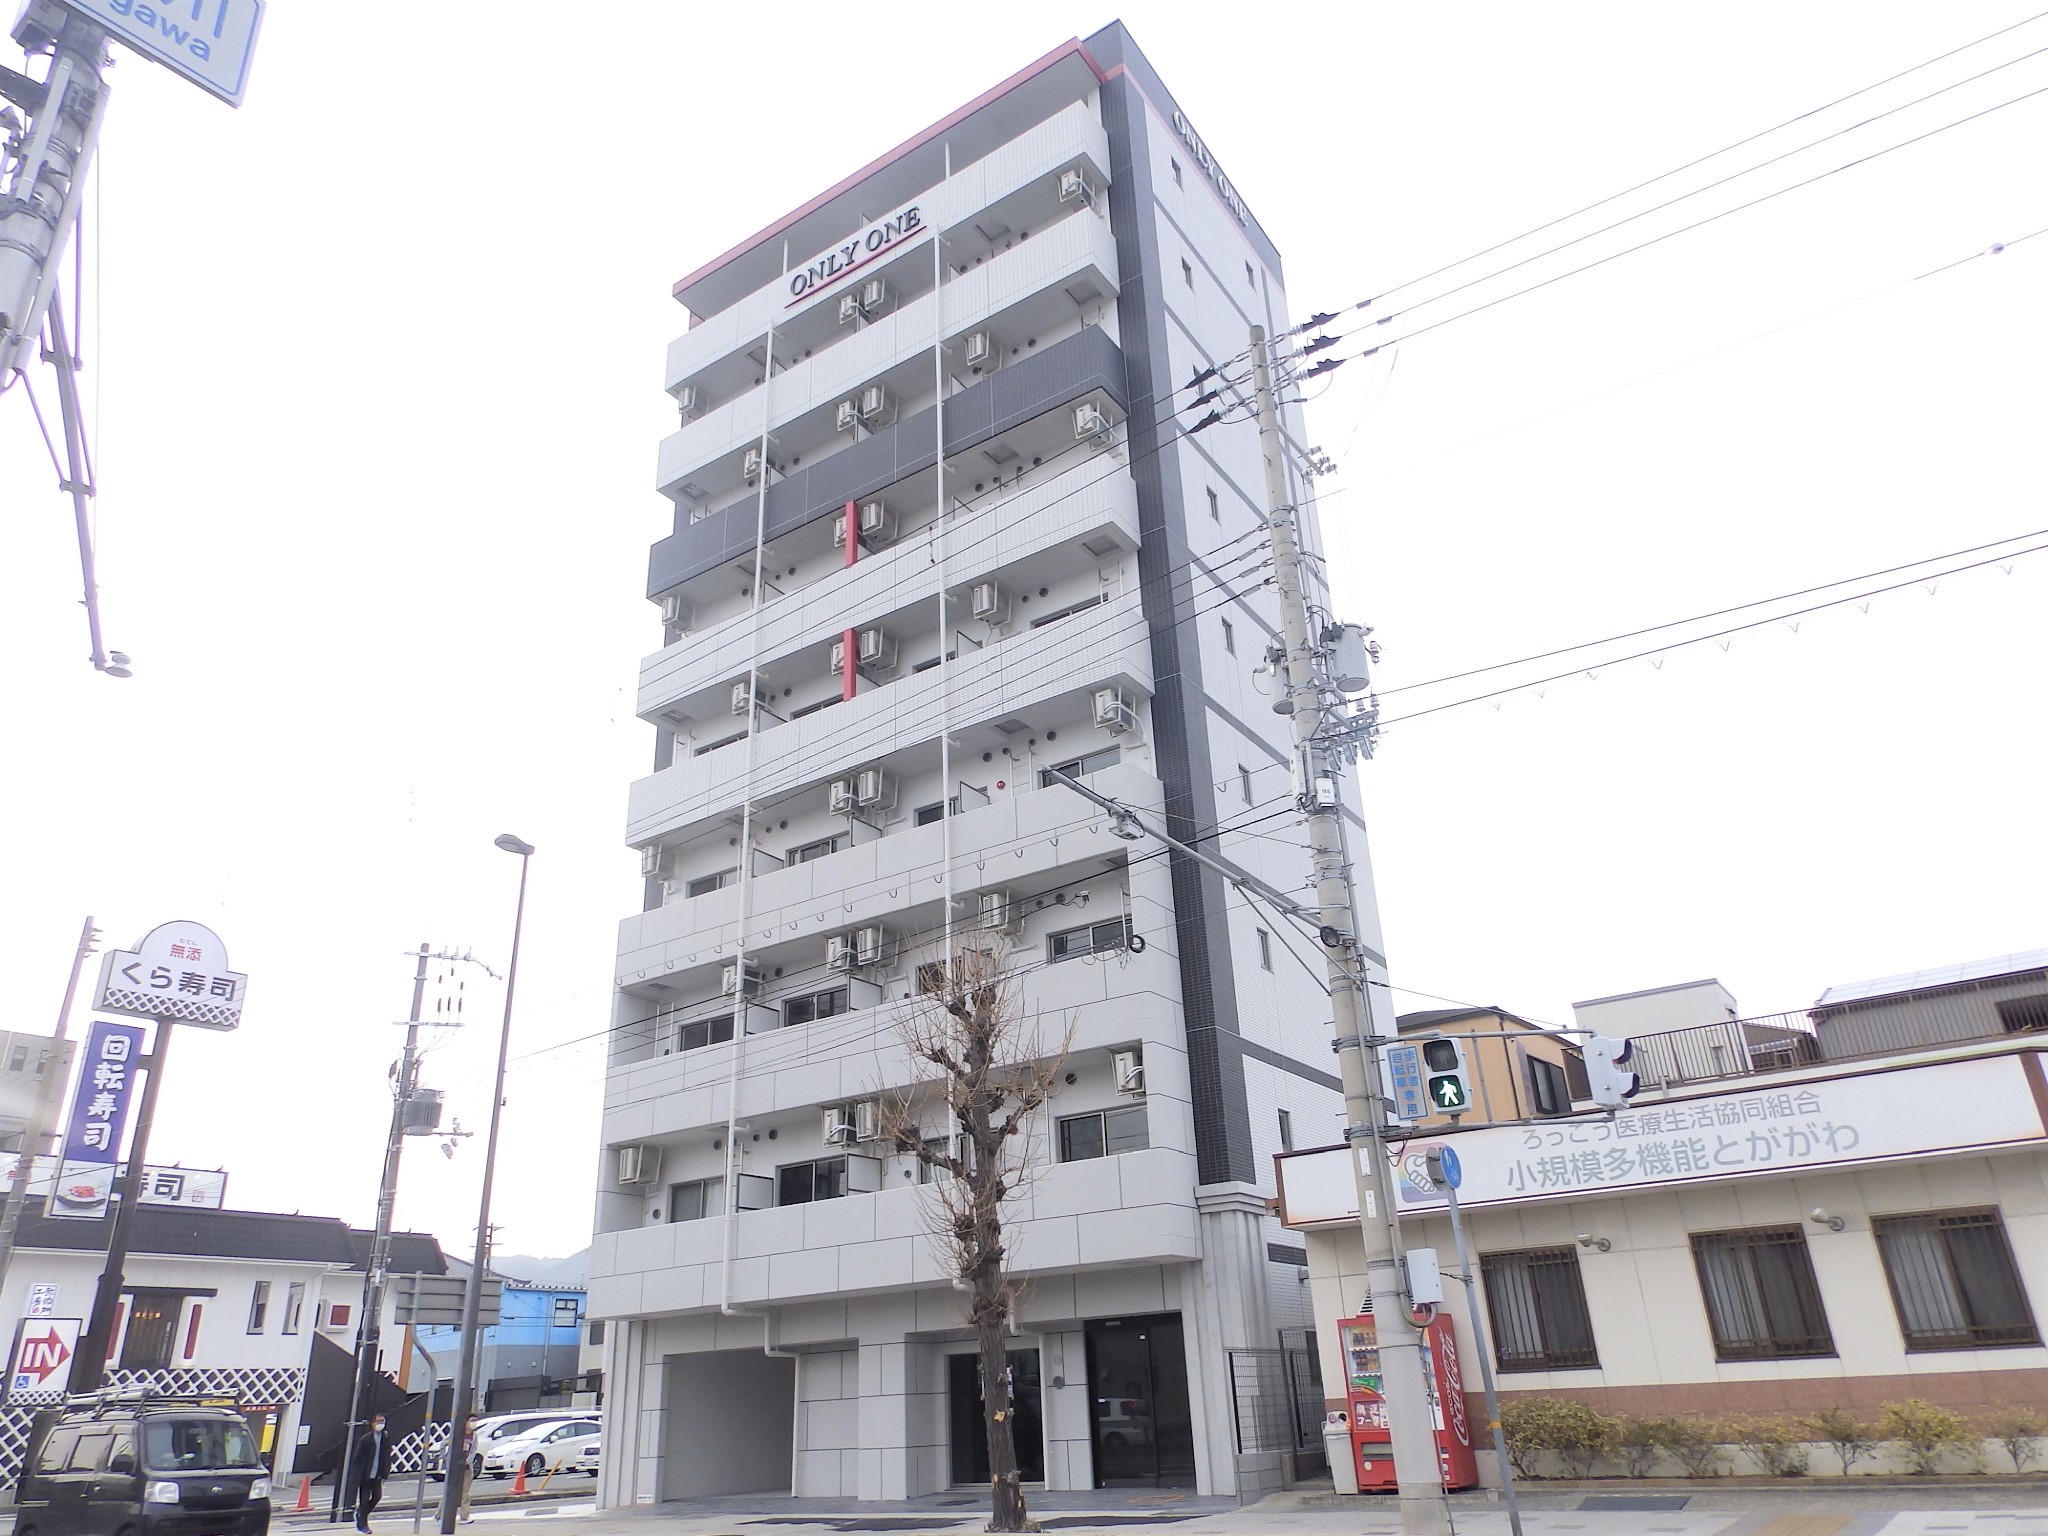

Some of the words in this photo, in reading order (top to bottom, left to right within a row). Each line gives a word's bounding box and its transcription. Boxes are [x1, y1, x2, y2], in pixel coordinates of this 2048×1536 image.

[1172, 111, 1215, 180] ONLY
[1216, 175, 1248, 227] ONE
[790, 240, 860, 296] ONLY
[865, 206, 921, 252] ONE
[121, 962, 236, 1001] くら寿司
[171, 944, 202, 961] 無添
[84, 1033, 132, 1151] 回転寿司
[1523, 1090, 1821, 1149] ろっこう医療生活協同組合
[1507, 1120, 1860, 1192] 小規模多機能とががわ
[22, 1343, 62, 1368] IN
